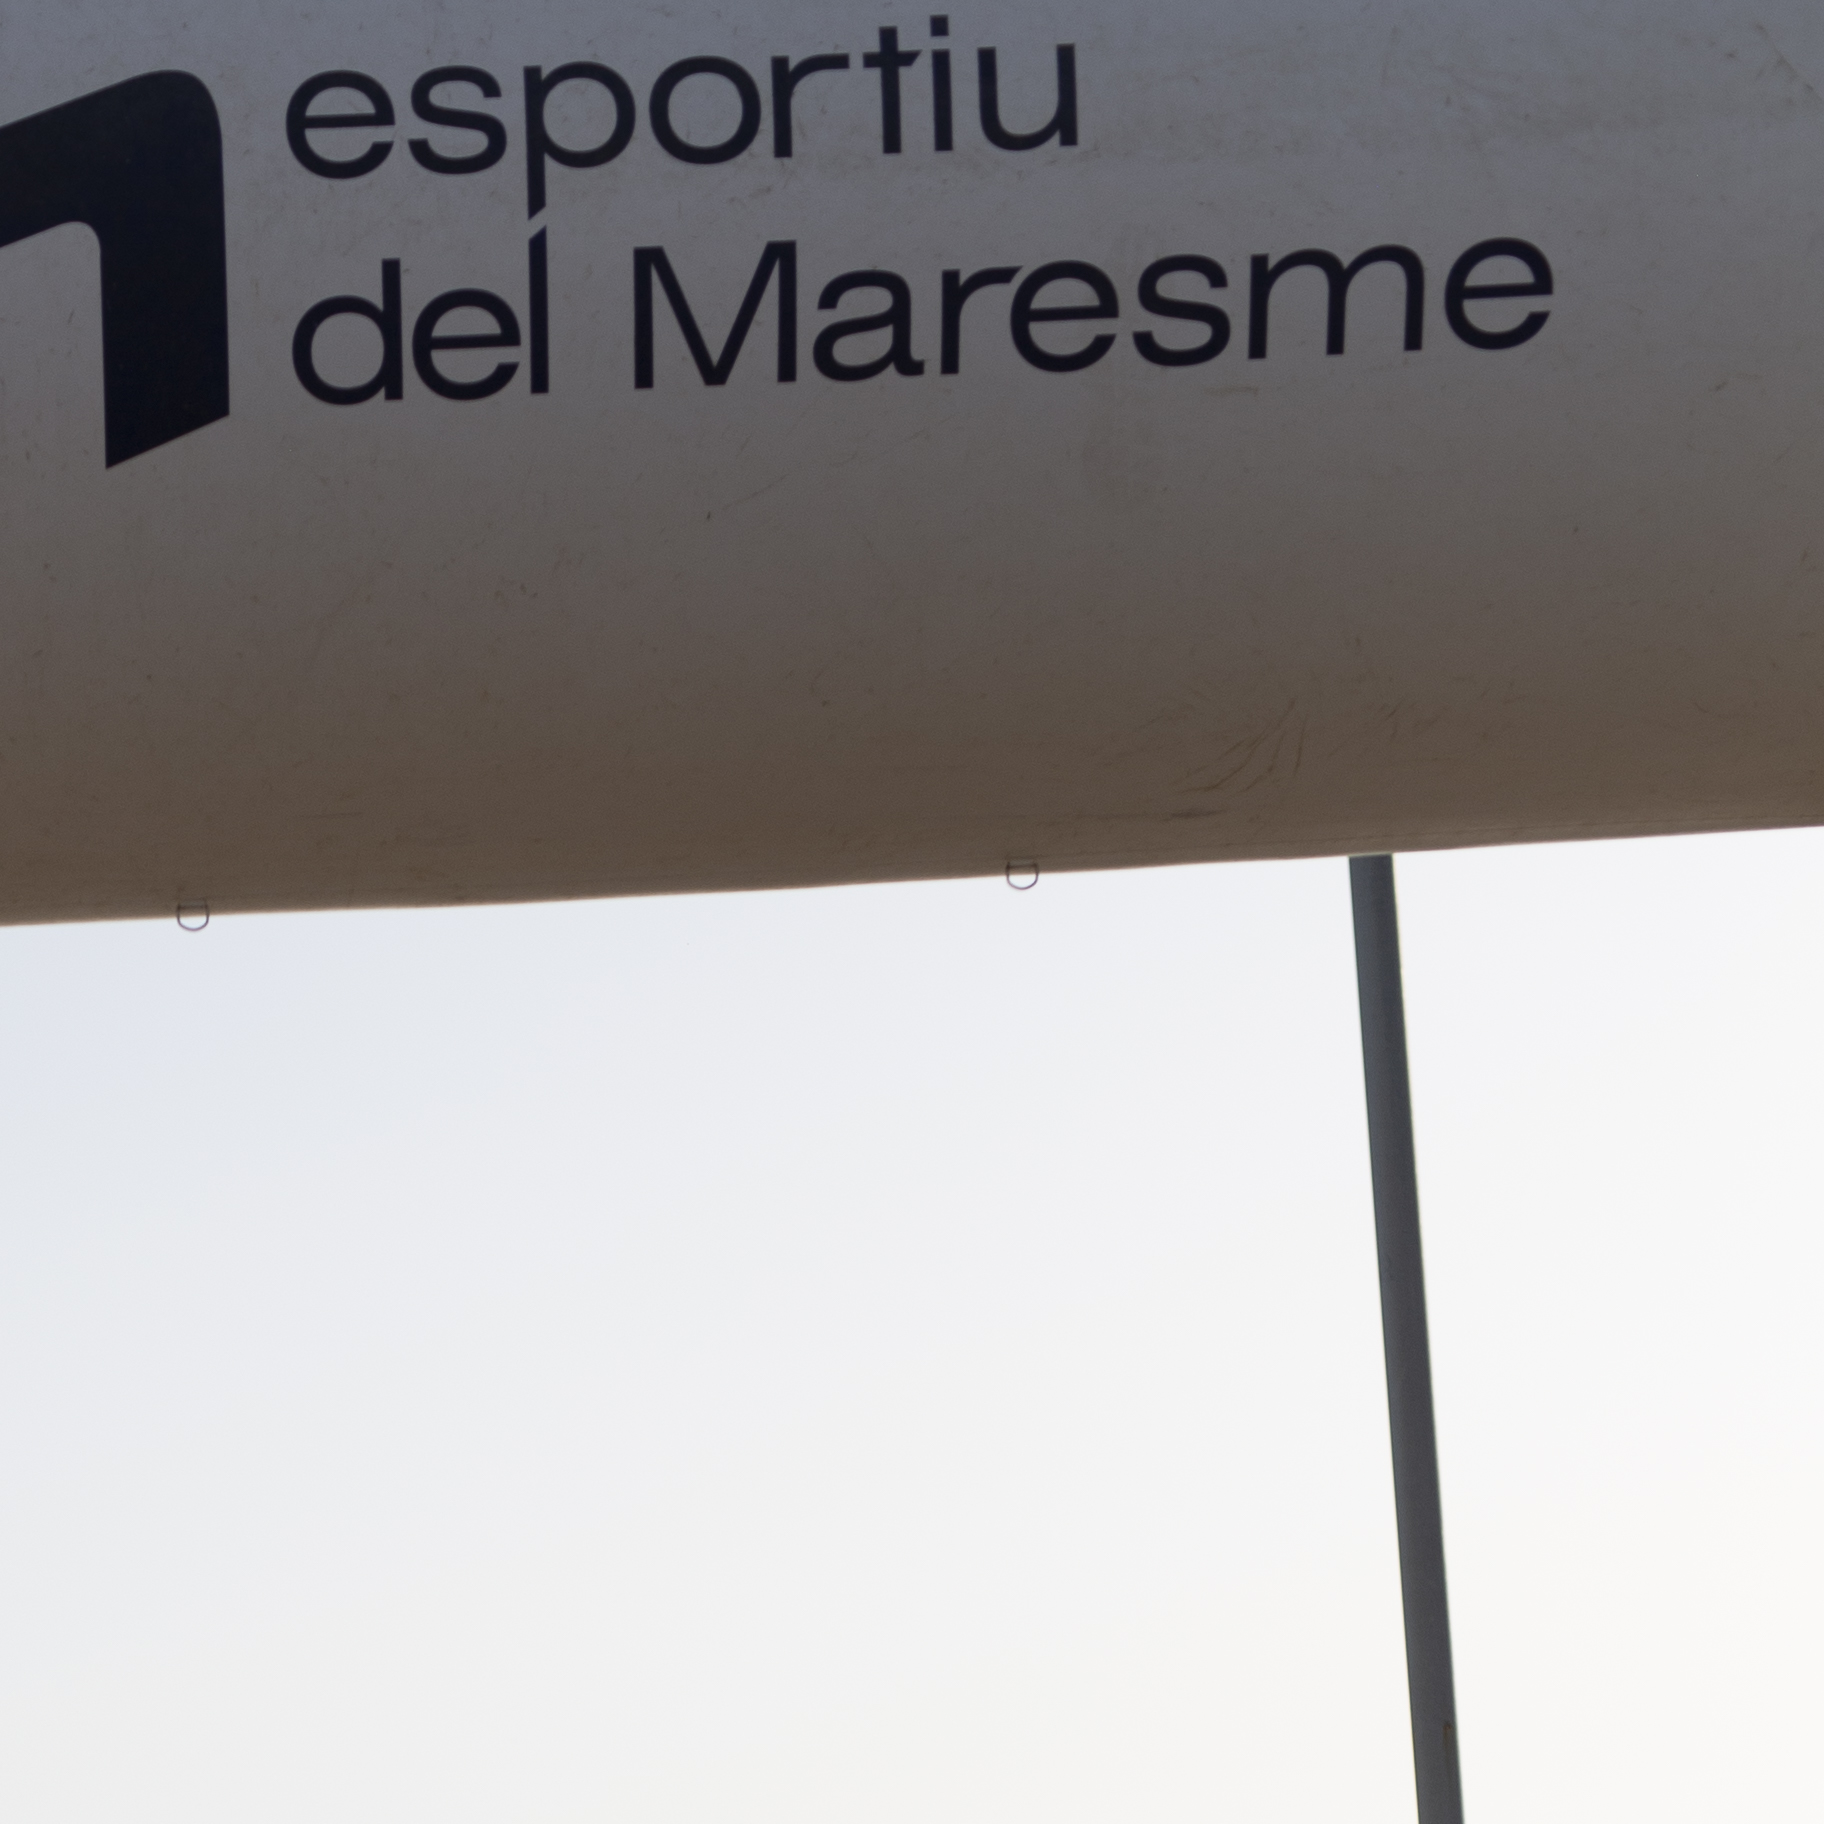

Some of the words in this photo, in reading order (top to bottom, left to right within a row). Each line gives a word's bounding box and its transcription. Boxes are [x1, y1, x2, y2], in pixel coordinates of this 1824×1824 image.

[284, 14, 1079, 221] esportiu
[291, 224, 550, 406] del
[632, 236, 1556, 390] Maresme
